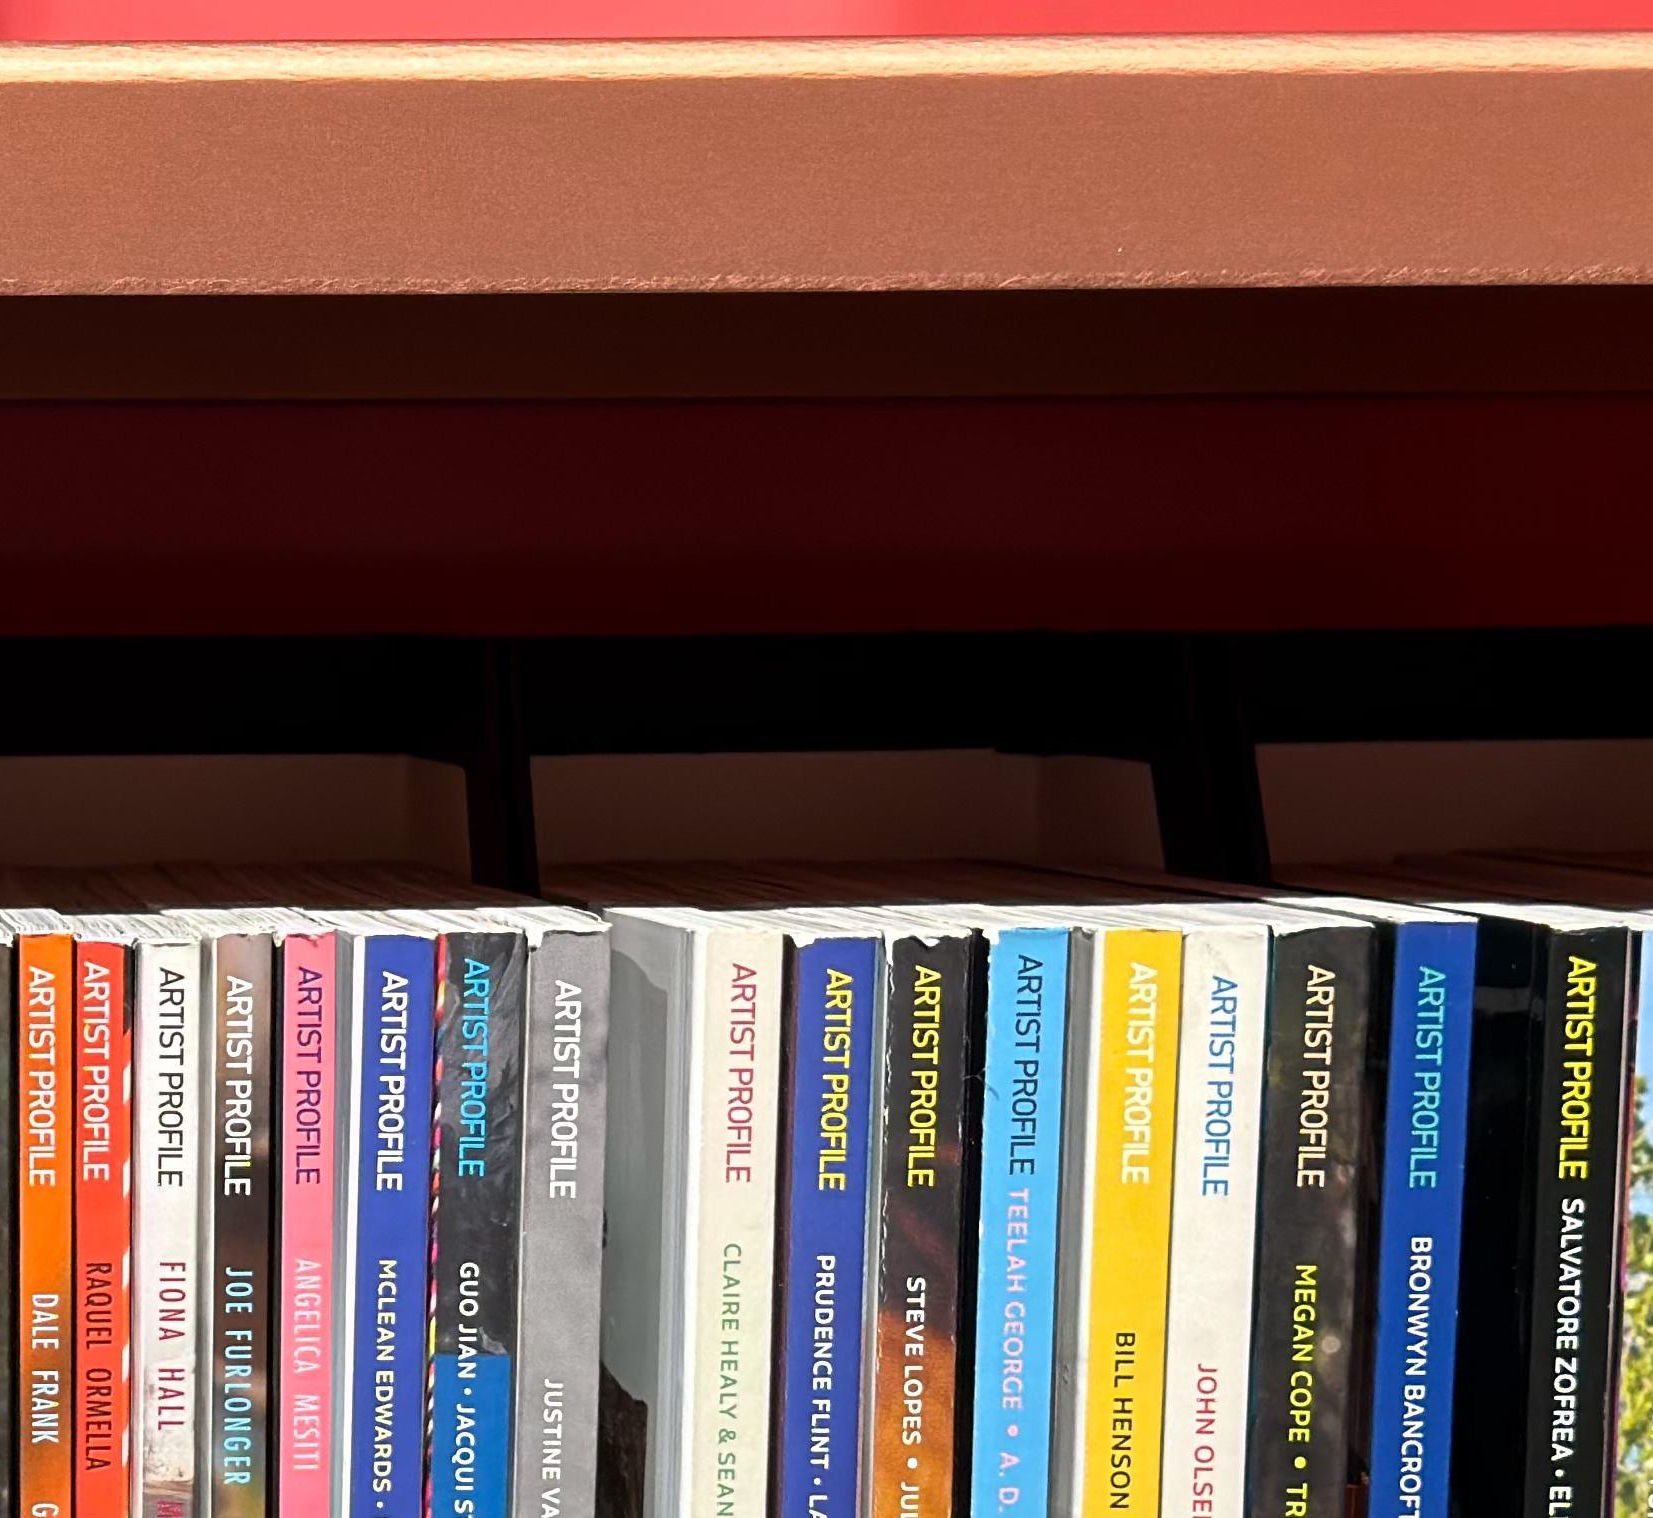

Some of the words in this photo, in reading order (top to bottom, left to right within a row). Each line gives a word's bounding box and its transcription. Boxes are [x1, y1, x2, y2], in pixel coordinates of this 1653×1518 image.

[297, 967, 322, 1063] ARTIST
[1209, 976, 1238, 1074] ARTIST
[1565, 956, 1596, 1056] ARTIST
[296, 1071, 321, 1184] PROFILE
[1203, 1081, 1233, 1196] PROFILE
[1559, 1062, 1592, 1178] PROFILE
[294, 1259, 321, 1373] ANGELICA
[459, 1263, 479, 1316] GUO
[458, 1324, 477, 1378] JIAN
[1196, 1364, 1217, 1434] JOHN
[294, 1395, 320, 1469] MESITI
